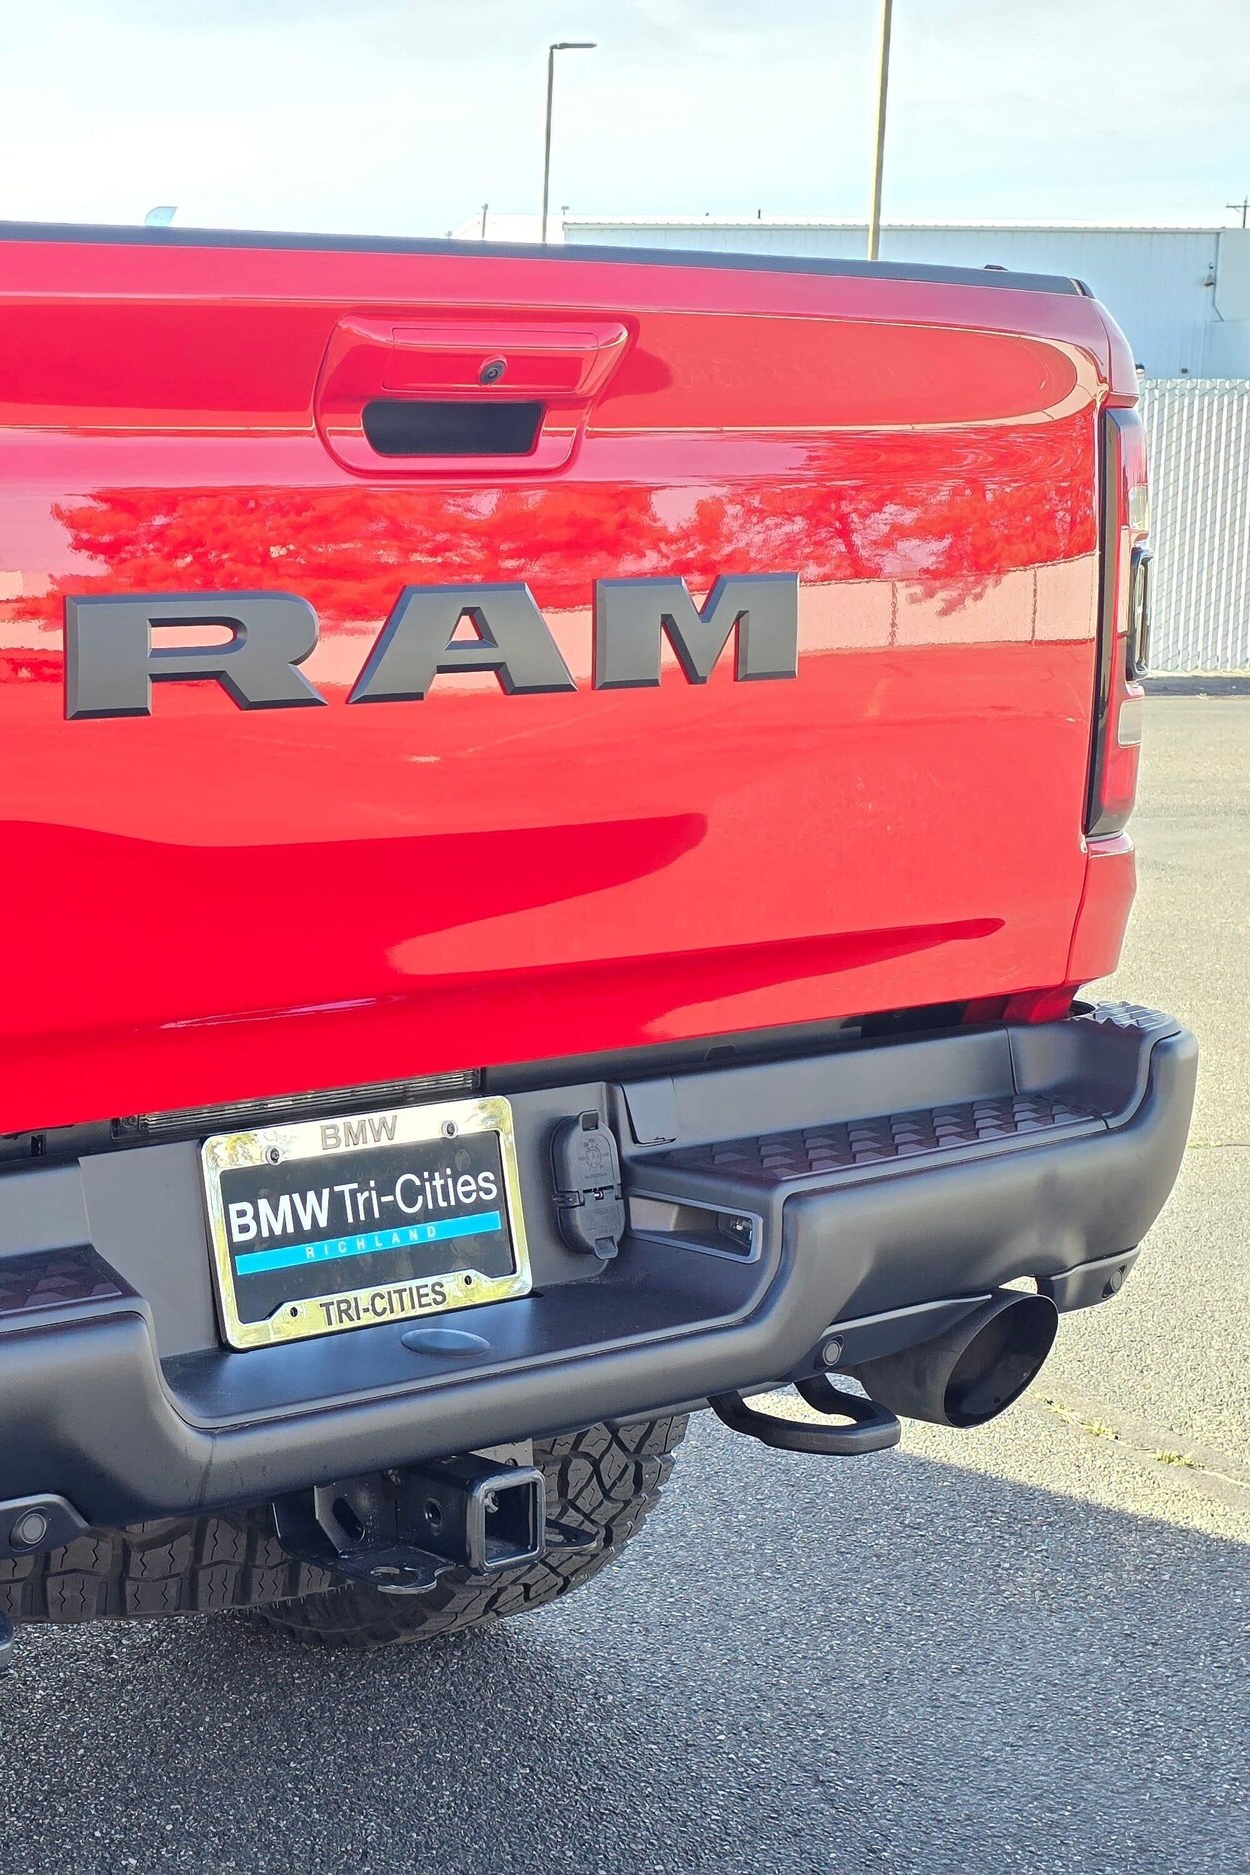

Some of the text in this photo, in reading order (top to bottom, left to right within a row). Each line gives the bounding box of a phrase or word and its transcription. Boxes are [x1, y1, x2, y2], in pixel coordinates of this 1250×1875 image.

[64, 571, 799, 720] RAM
[320, 1115, 398, 1150] BMW
[228, 1170, 498, 1243] BMW Tri-Cities
[305, 1225, 437, 1259] RICHLAND
[320, 1281, 447, 1327] TRI-CITIES
